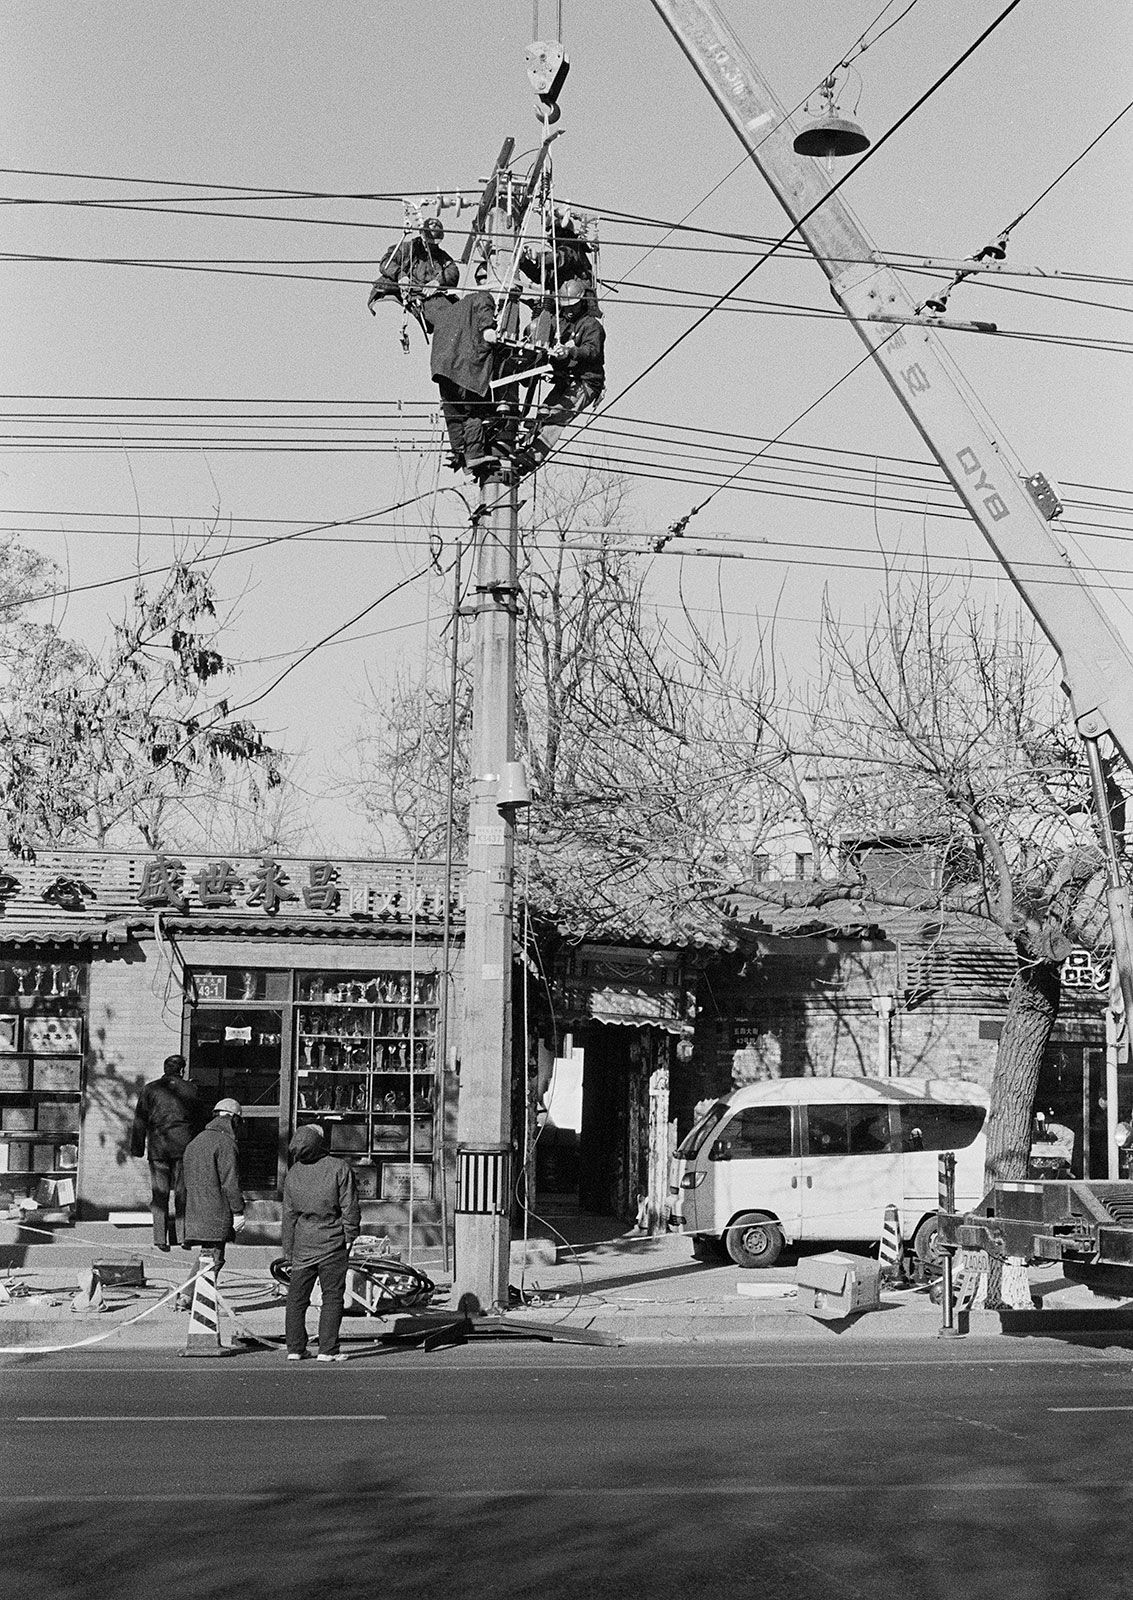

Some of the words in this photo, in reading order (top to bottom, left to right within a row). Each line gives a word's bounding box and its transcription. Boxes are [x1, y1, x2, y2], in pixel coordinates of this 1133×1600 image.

[137, 857, 338, 911] 盛世永昌
[198, 986, 218, 997] 43-1
